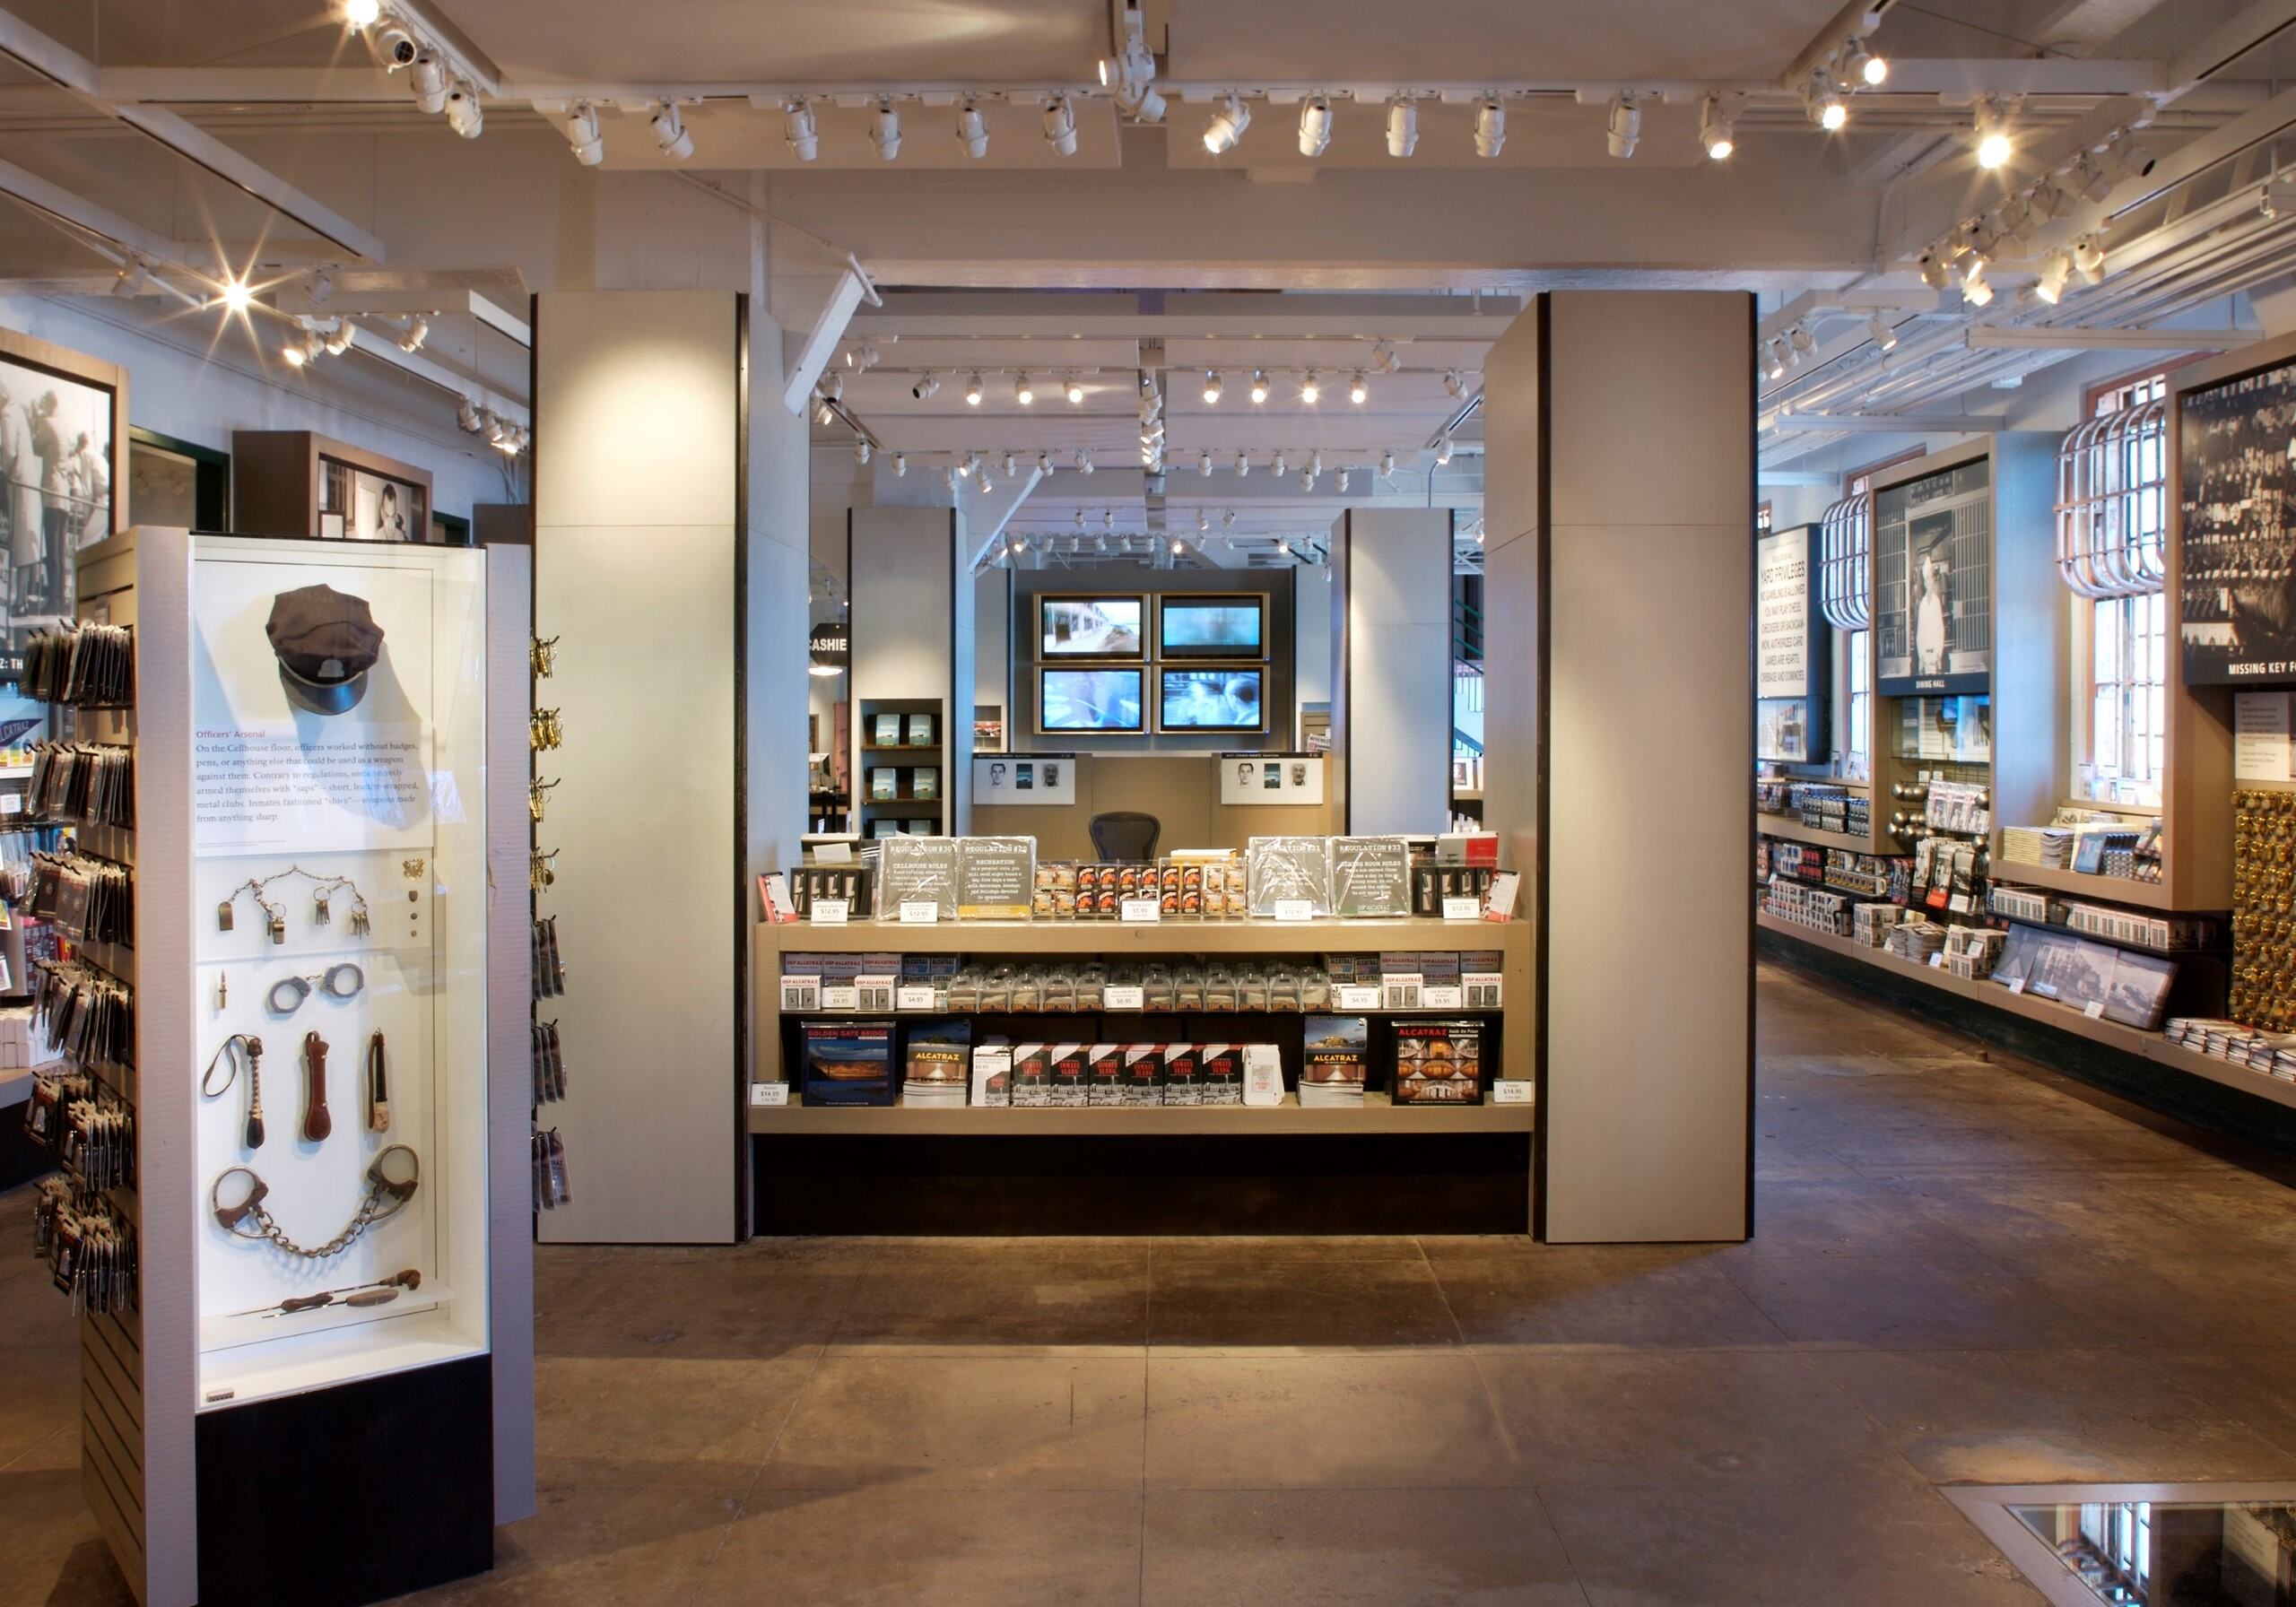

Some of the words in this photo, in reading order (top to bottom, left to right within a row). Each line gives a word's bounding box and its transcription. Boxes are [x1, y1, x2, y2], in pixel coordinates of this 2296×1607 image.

[1761, 566, 1774, 584] YARD
[1775, 560, 1805, 582] PRIVILEGES
[2229, 663, 2266, 675] MISSING
[2268, 662, 2286, 673] KEY
[1916, 681, 1932, 689] DINING
[1933, 680, 1944, 688] HALL
[234, 730, 265, 738] Arsenal
[196, 744, 209, 752] On
[212, 744, 225, 752] the
[227, 743, 268, 752] Cellhouse
[271, 743, 293, 752] floor,
[294, 743, 325, 751] officers
[327, 743, 356, 751] worked
[358, 743, 387, 751] without
[390, 743, 418, 751] badges,
[232, 758, 267, 768] anything
[287, 757, 301, 765] that
[196, 773, 225, 782] against
[228, 772, 251, 780] them.
[253, 771, 290, 781] Contrary
[303, 770, 350, 779] regulations,
[196, 786, 223, 795] armed
[225, 785, 271, 795] themselves
[273, 785, 291, 793] with
[283, 797, 322, 805] fashioned
[196, 813, 216, 822] from
[218, 812, 254, 822] anything
[256, 812, 279, 821] sharp.
[916, 1052, 960, 1061] ALCATRAZ
